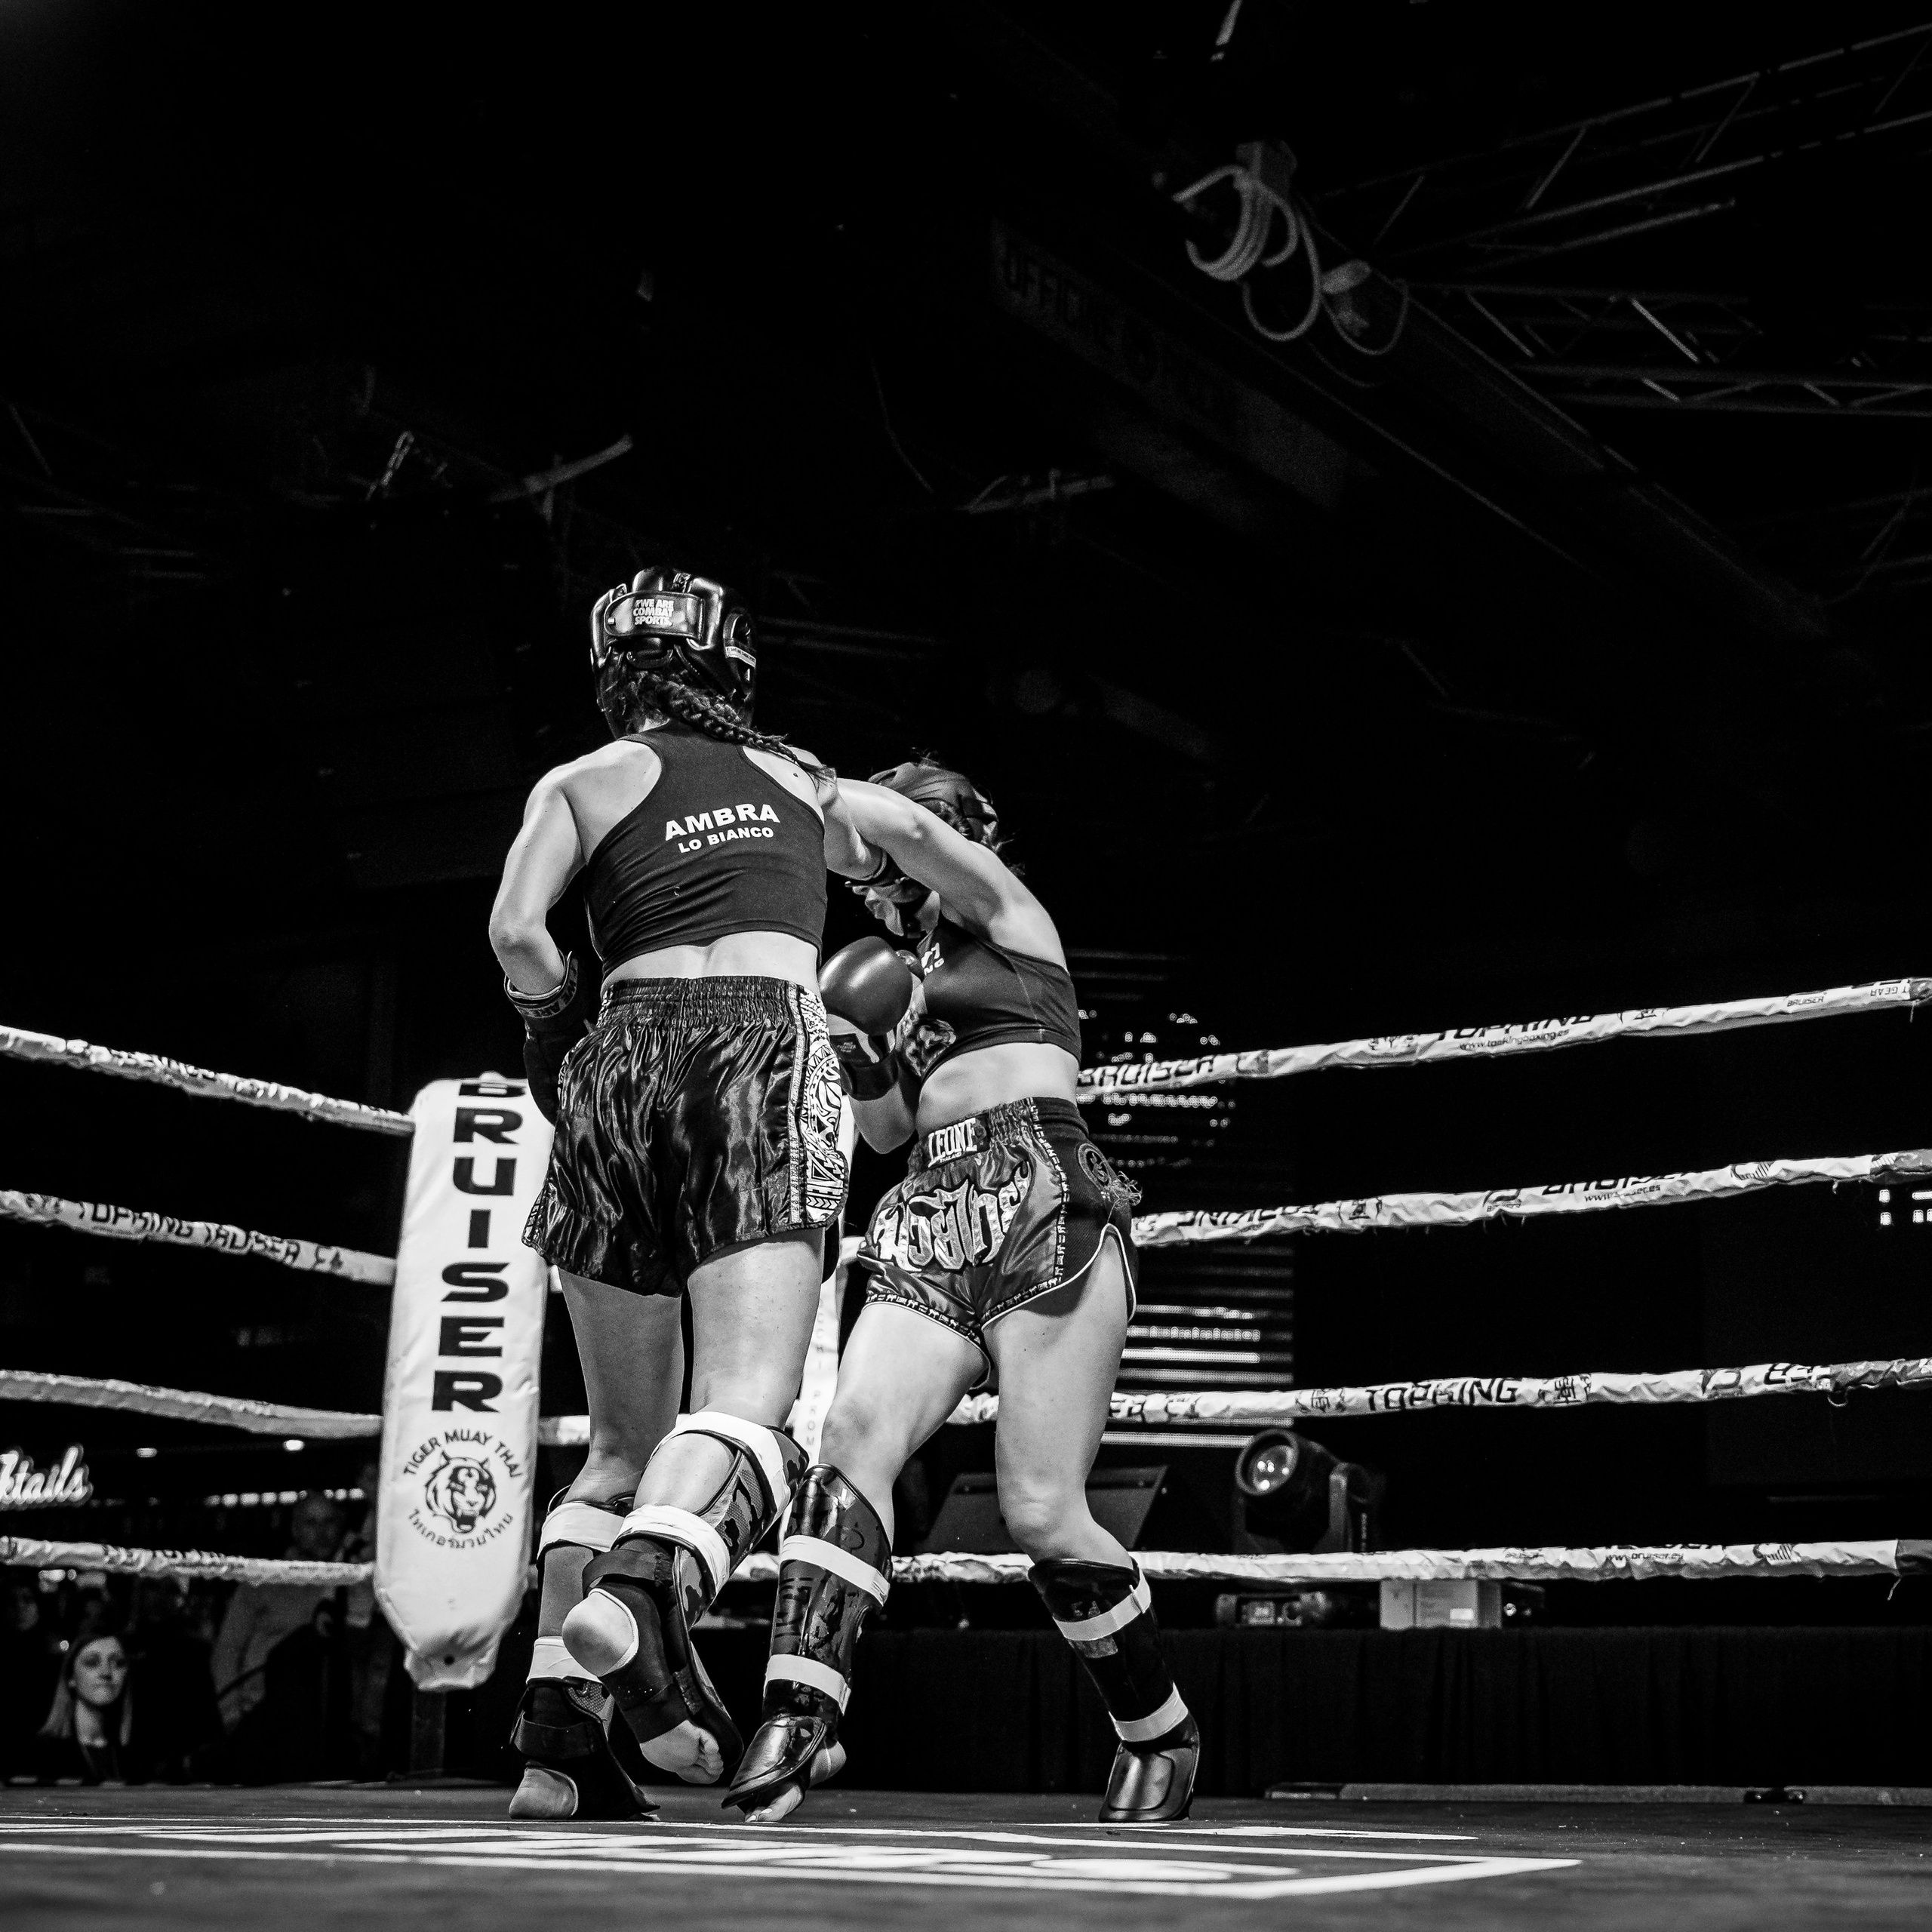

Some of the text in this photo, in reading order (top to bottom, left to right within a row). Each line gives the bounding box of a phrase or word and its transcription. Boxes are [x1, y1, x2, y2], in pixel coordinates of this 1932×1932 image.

[633, 607, 674, 617] COMBAT
[665, 803, 780, 841] AMBRA
[678, 827, 774, 853] LO BIANCO
[928, 1117, 977, 1168] LEONE
[404, 1428, 523, 1478] TIGER MUAY THAI
